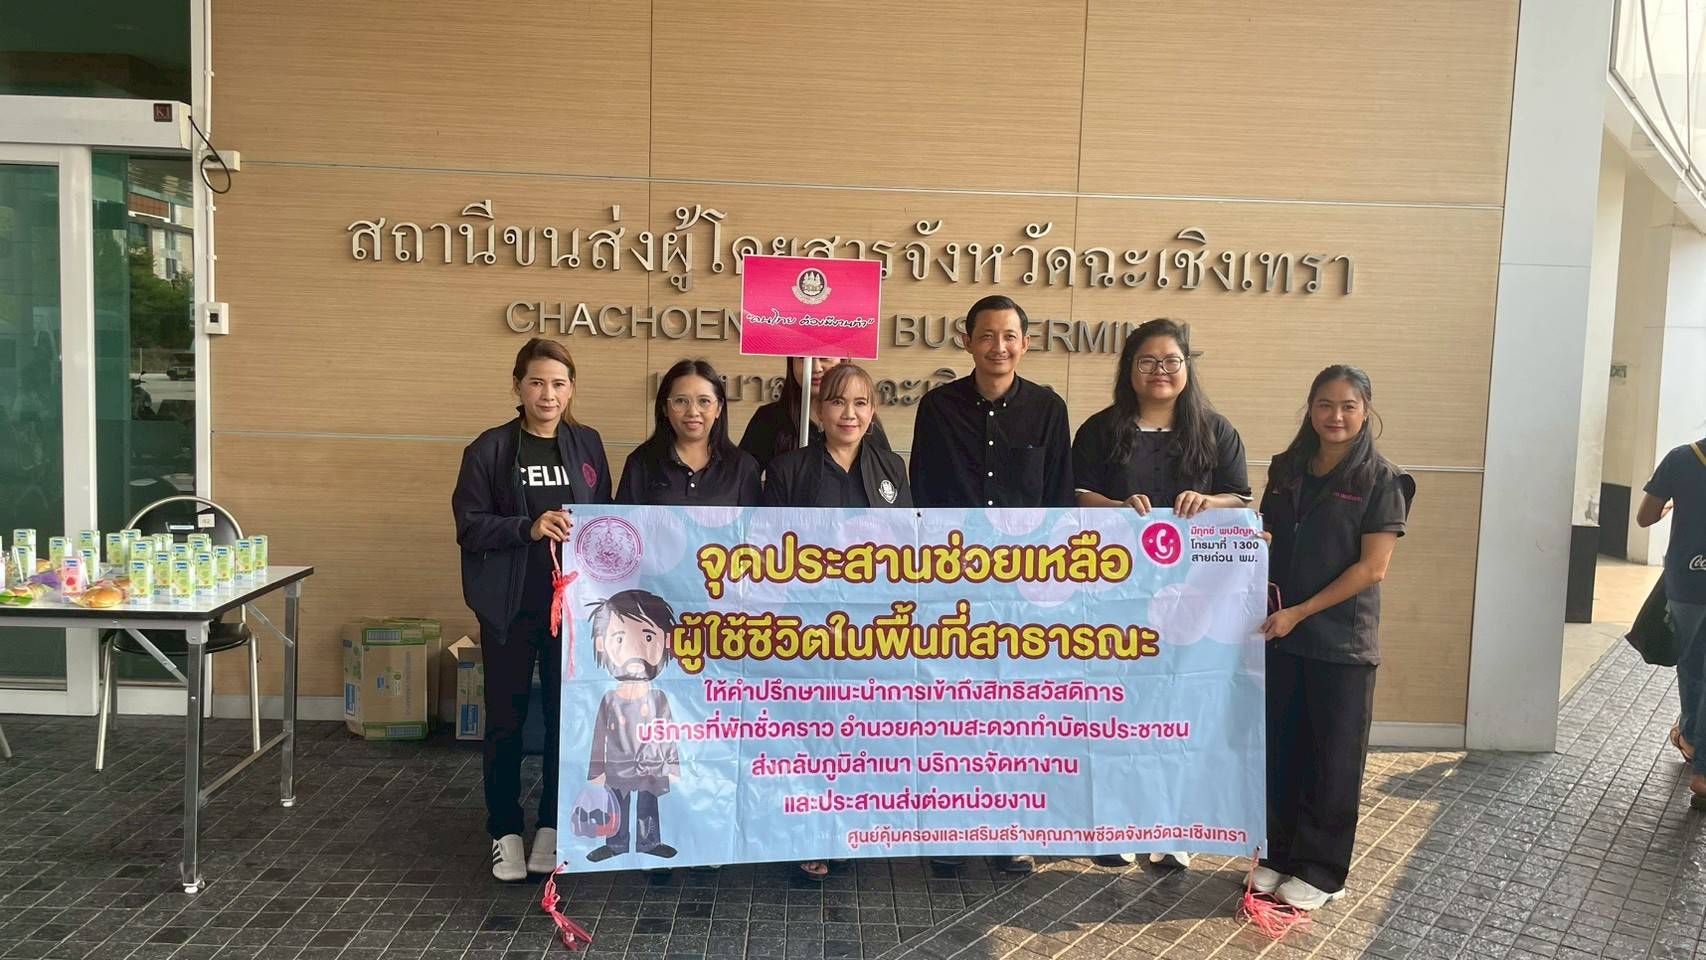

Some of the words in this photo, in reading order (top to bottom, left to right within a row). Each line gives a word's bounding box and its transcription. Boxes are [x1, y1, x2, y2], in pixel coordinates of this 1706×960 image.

[505, 301, 742, 341] CHACHOEN
[1028, 319, 1203, 356] ERMIL
[1190, 537, 1227, 549] โทรมาที่
[1233, 541, 1259, 549] 1300
[1219, 526, 1255, 537] พบปัญห
[698, 530, 1131, 598] จุดประสานช่วยเหลือ
[1191, 552, 1233, 562] สายด่วน
[1239, 554, 1258, 562] พม.
[671, 600, 1159, 673] ผู้ใช้ชีวิตในพื้นที่สาธารณะ
[705, 678, 1124, 701] ให้คำปรึกษาแนะนำการเข้าถึงสิทธิสวัสดิการ
[638, 711, 834, 741] บริการที่พักชั่วคราว
[840, 714, 1189, 738] อำนวยความสะดวกทำบัตรประชาชน
[752, 751, 910, 780] ส่งกลับภูมิลำเนา
[918, 752, 1078, 773] บริการจัดหางาน
[784, 788, 1046, 812] และประสานส่งต่อหน่วยงาน
[848, 824, 1247, 848] ศูนย์คุ้มครองและเสริมสร้างคุณภาพชีวิตจังหวัดฉะเชิงเทรา
